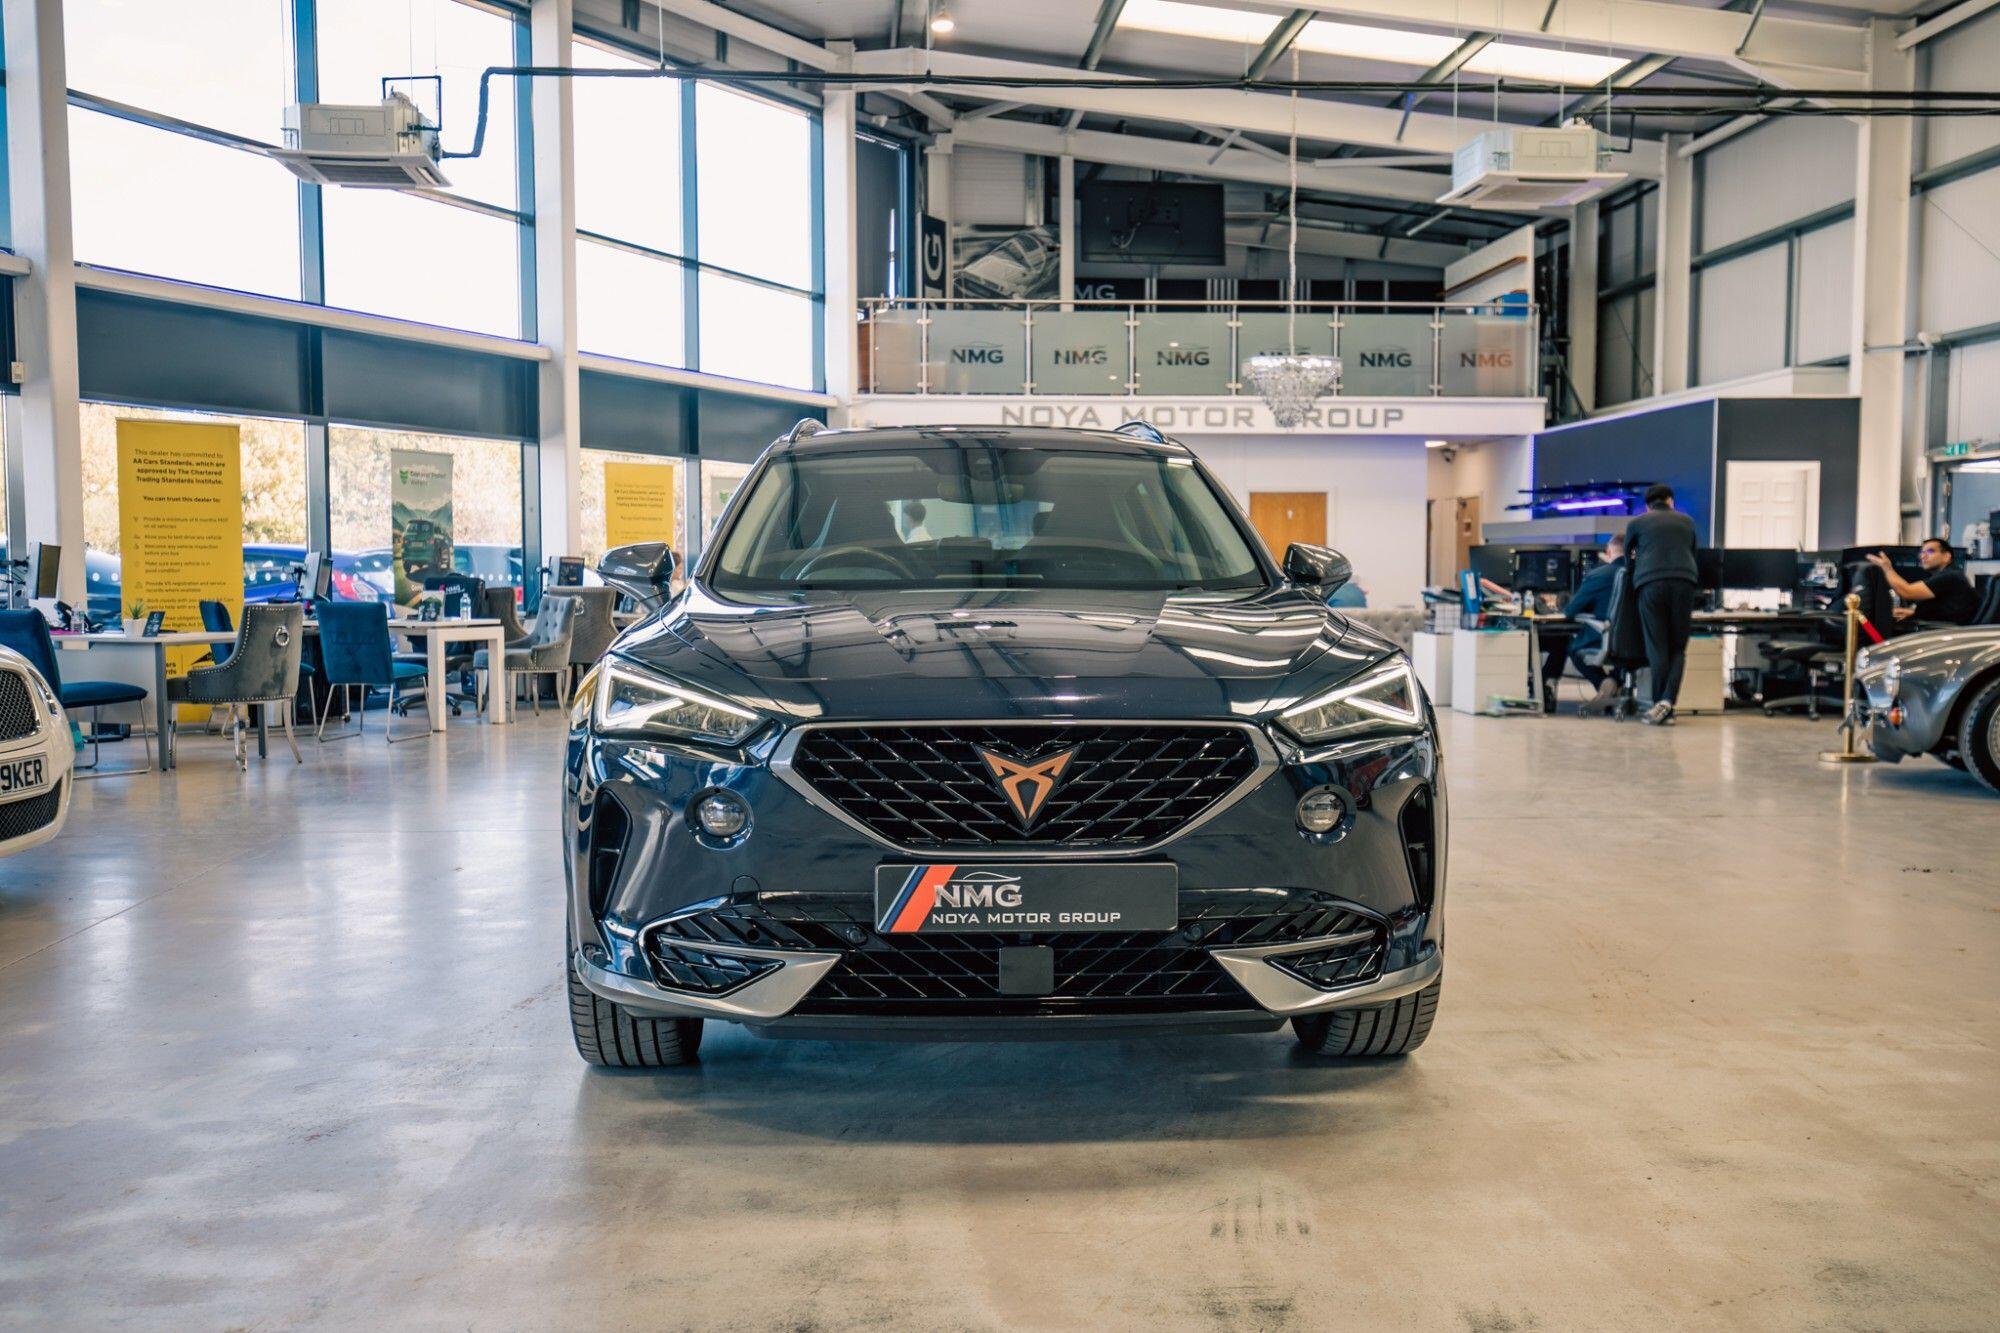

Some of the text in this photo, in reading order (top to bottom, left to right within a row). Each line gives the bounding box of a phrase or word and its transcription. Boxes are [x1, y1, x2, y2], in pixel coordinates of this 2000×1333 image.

[1074, 284, 1116, 300] MG
[952, 349, 1004, 364] NMG
[1054, 350, 1107, 365] NMG
[1157, 351, 1210, 366] NMG
[1360, 352, 1412, 368] NMG
[1461, 352, 1512, 368] NMG
[1002, 406, 1403, 428] NOYA MOTOR ROUP
[149, 449, 168, 457] dealer
[183, 450, 216, 458] committed
[160, 459, 194, 467] Standards,
[168, 468, 176, 476] by
[136, 476, 160, 484] Trading
[933, 884, 1023, 908] NMG
[932, 911, 1121, 924] NOYA MOTOR GROUP
